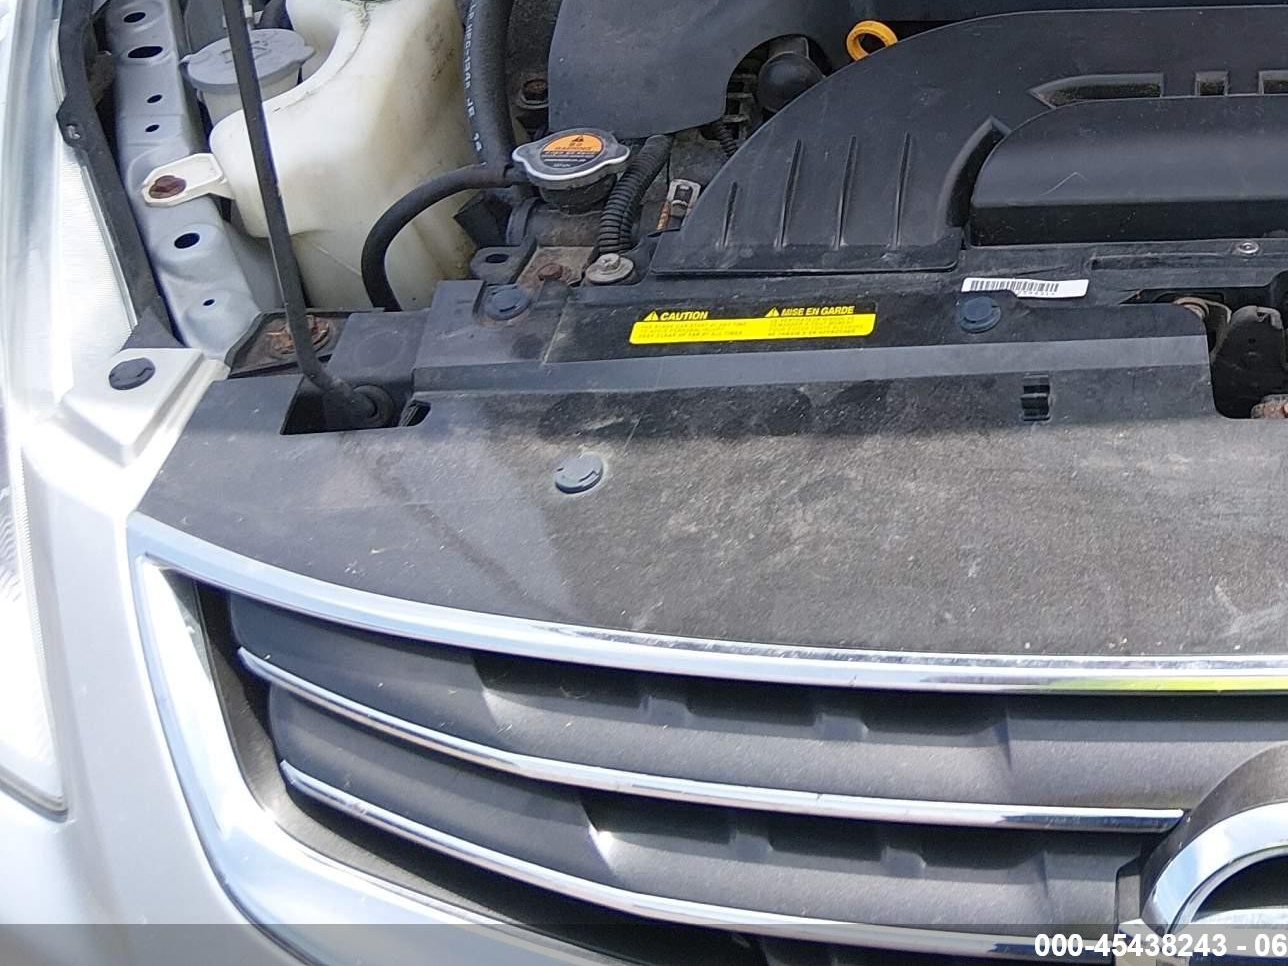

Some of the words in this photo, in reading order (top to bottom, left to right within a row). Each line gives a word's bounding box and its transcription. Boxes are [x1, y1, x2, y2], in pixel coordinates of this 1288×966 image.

[660, 311, 708, 321] CAUTION
[781, 308, 804, 316] MISE
[805, 307, 820, 316] EN
[820, 306, 855, 315] GARDE
